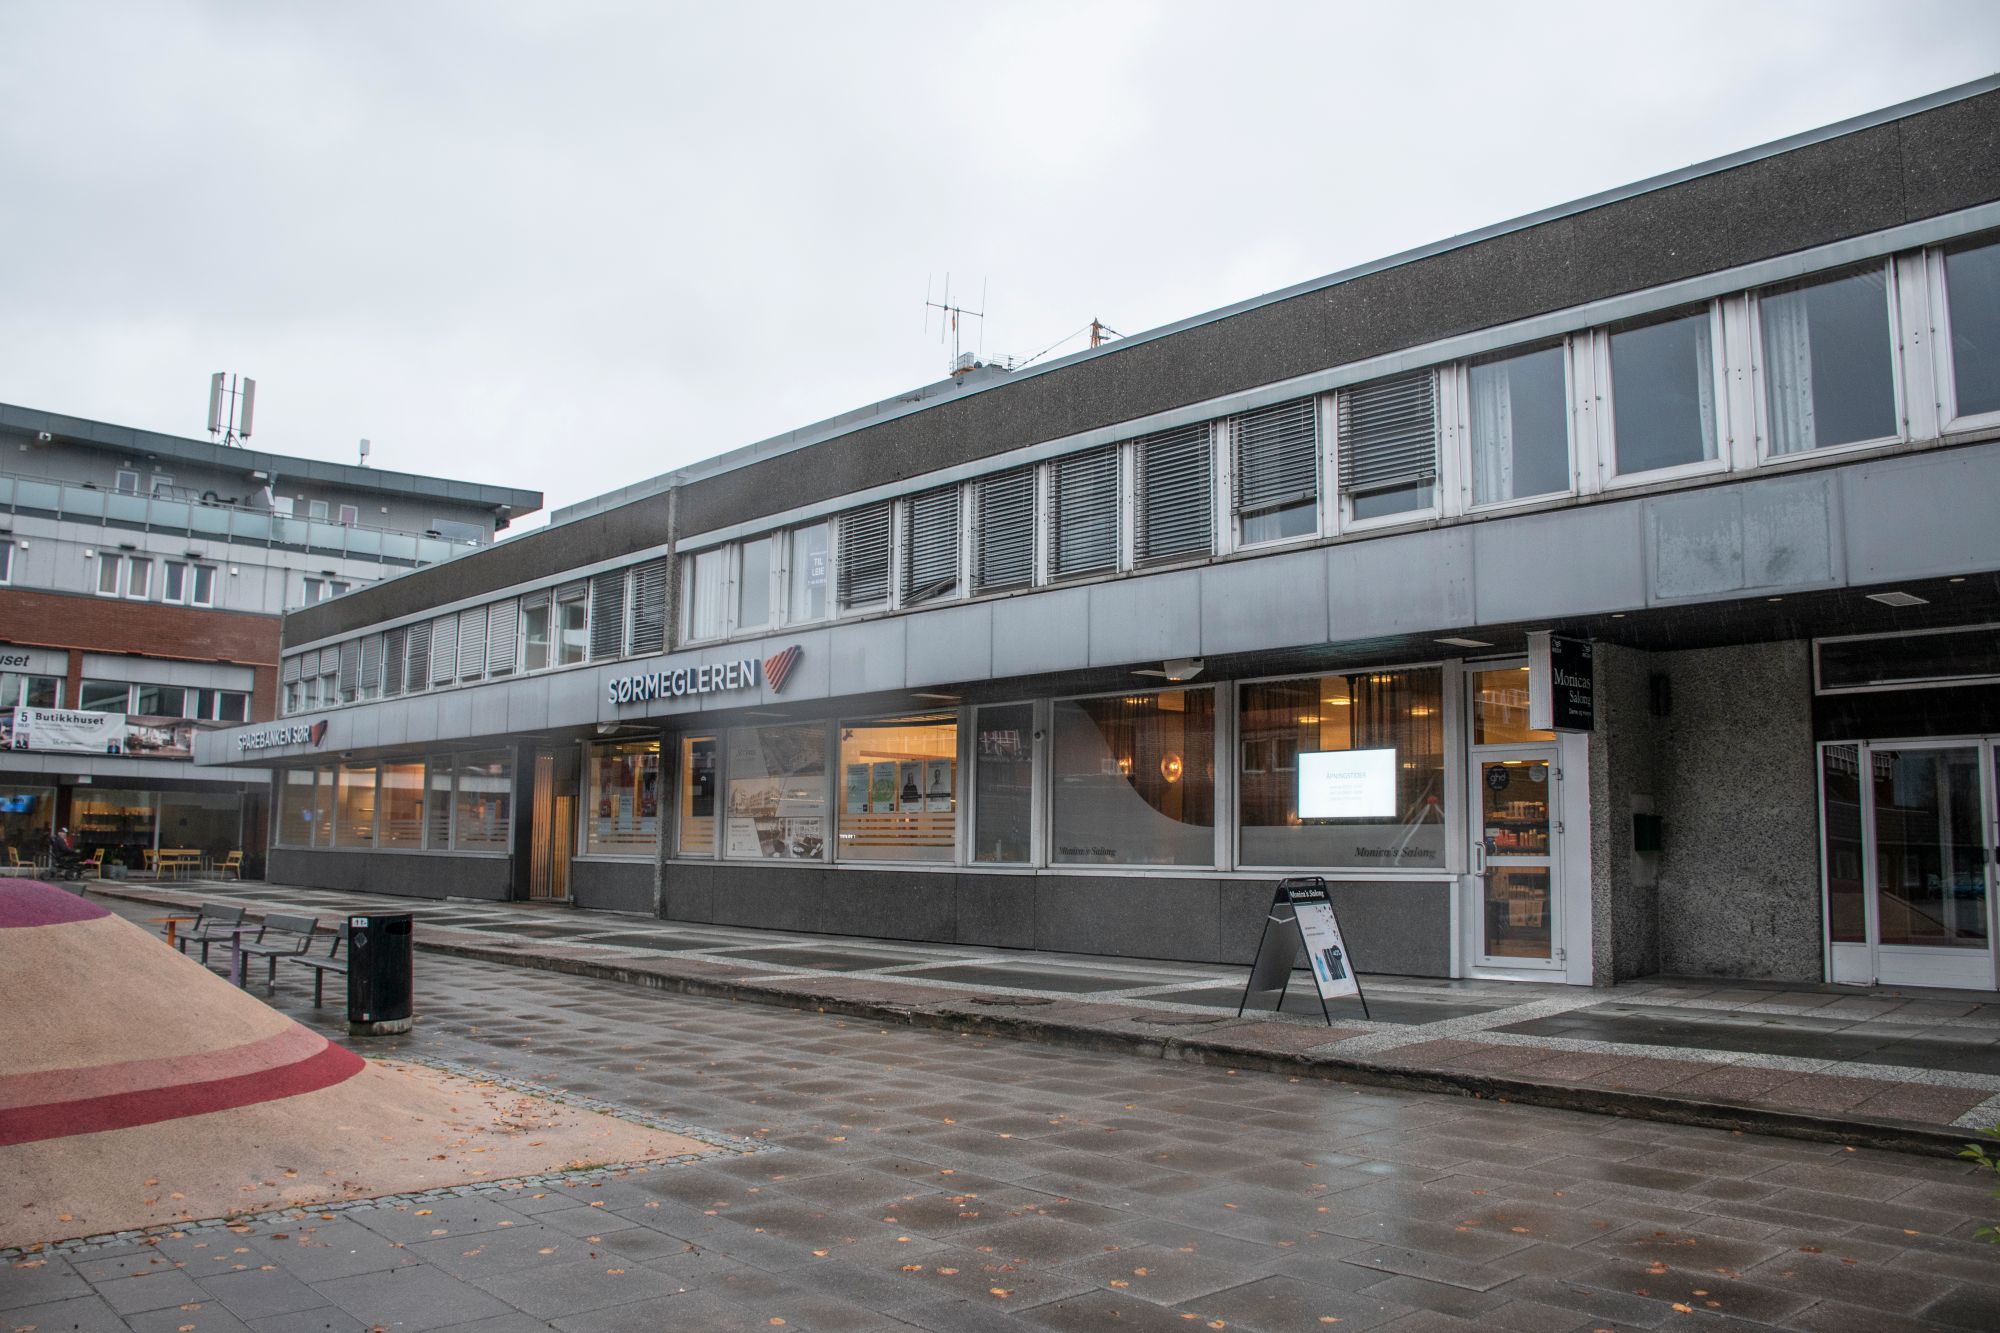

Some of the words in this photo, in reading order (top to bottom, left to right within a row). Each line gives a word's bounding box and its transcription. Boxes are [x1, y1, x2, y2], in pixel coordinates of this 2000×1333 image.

[813, 557, 823, 566] TIL
[811, 566, 825, 577] LEIE
[608, 658, 756, 705] SØRMEGLEREN
[1554, 667, 1591, 689] Monicas
[1569, 689, 1592, 707] Salong
[21, 711, 28, 722] 5
[35, 712, 105, 725] Butikkhuset
[238, 727, 291, 751] SPAREBANKEN
[292, 724, 310, 744] SØR
[1354, 847, 1400, 857] Monica's
[1401, 846, 1437, 859] Salong
